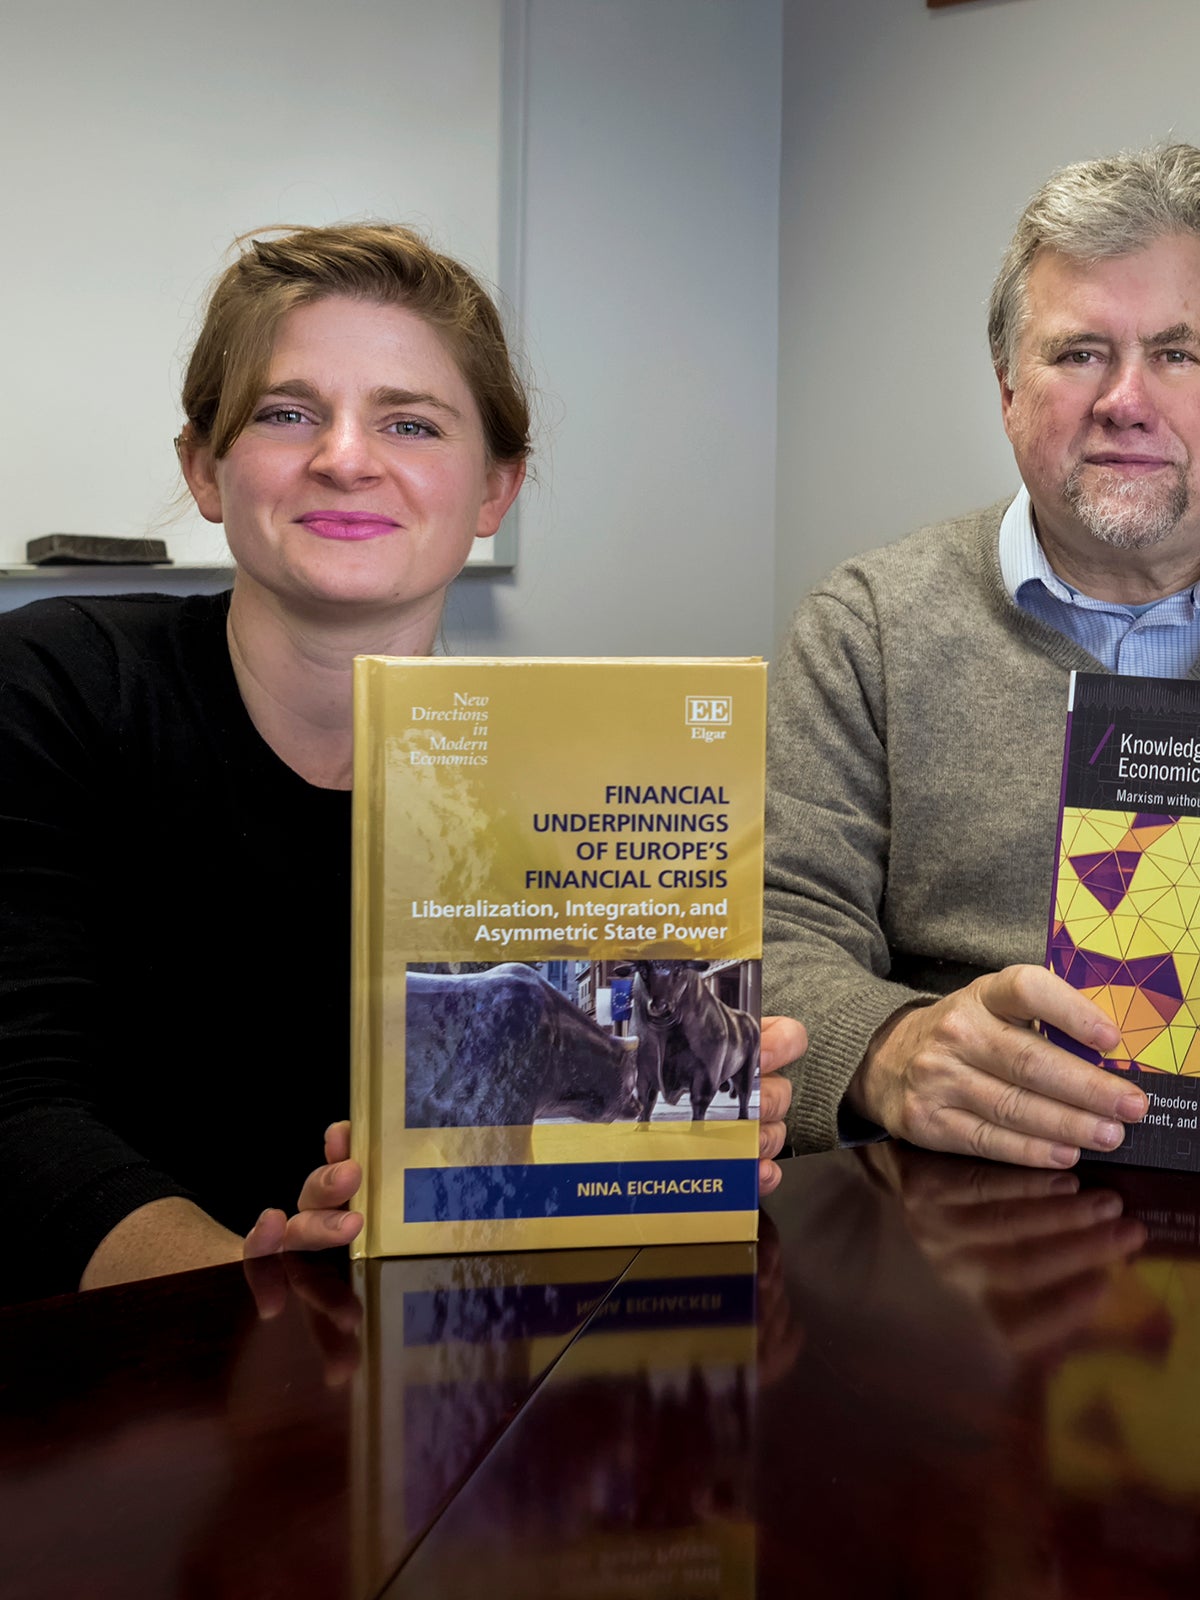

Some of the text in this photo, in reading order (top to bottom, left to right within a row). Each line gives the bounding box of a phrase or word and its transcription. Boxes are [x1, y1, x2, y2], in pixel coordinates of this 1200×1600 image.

[453, 692, 489, 706] New
[411, 706, 489, 721] Directions
[689, 699, 729, 722] EE
[473, 722, 488, 736] in
[691, 727, 727, 743] Elgar
[430, 736, 488, 750] Modern
[410, 751, 488, 765] Economics
[605, 785, 730, 805] FINANCIAL
[1116, 788, 1163, 805] Marxism
[533, 813, 729, 833] UNDERPINNINGS
[576, 841, 608, 860] OF
[525, 869, 728, 889] FINANCIAL CRISIS
[411, 899, 728, 919] Liberalization, Integration, and
[474, 924, 728, 945] Asymmetric State Power
[1147, 1093, 1198, 1111] Theodore
[1138, 1113, 1173, 1128] rnett,
[1177, 1117, 1198, 1130] and
[576, 1178, 724, 1198] NINA EICHACKER
